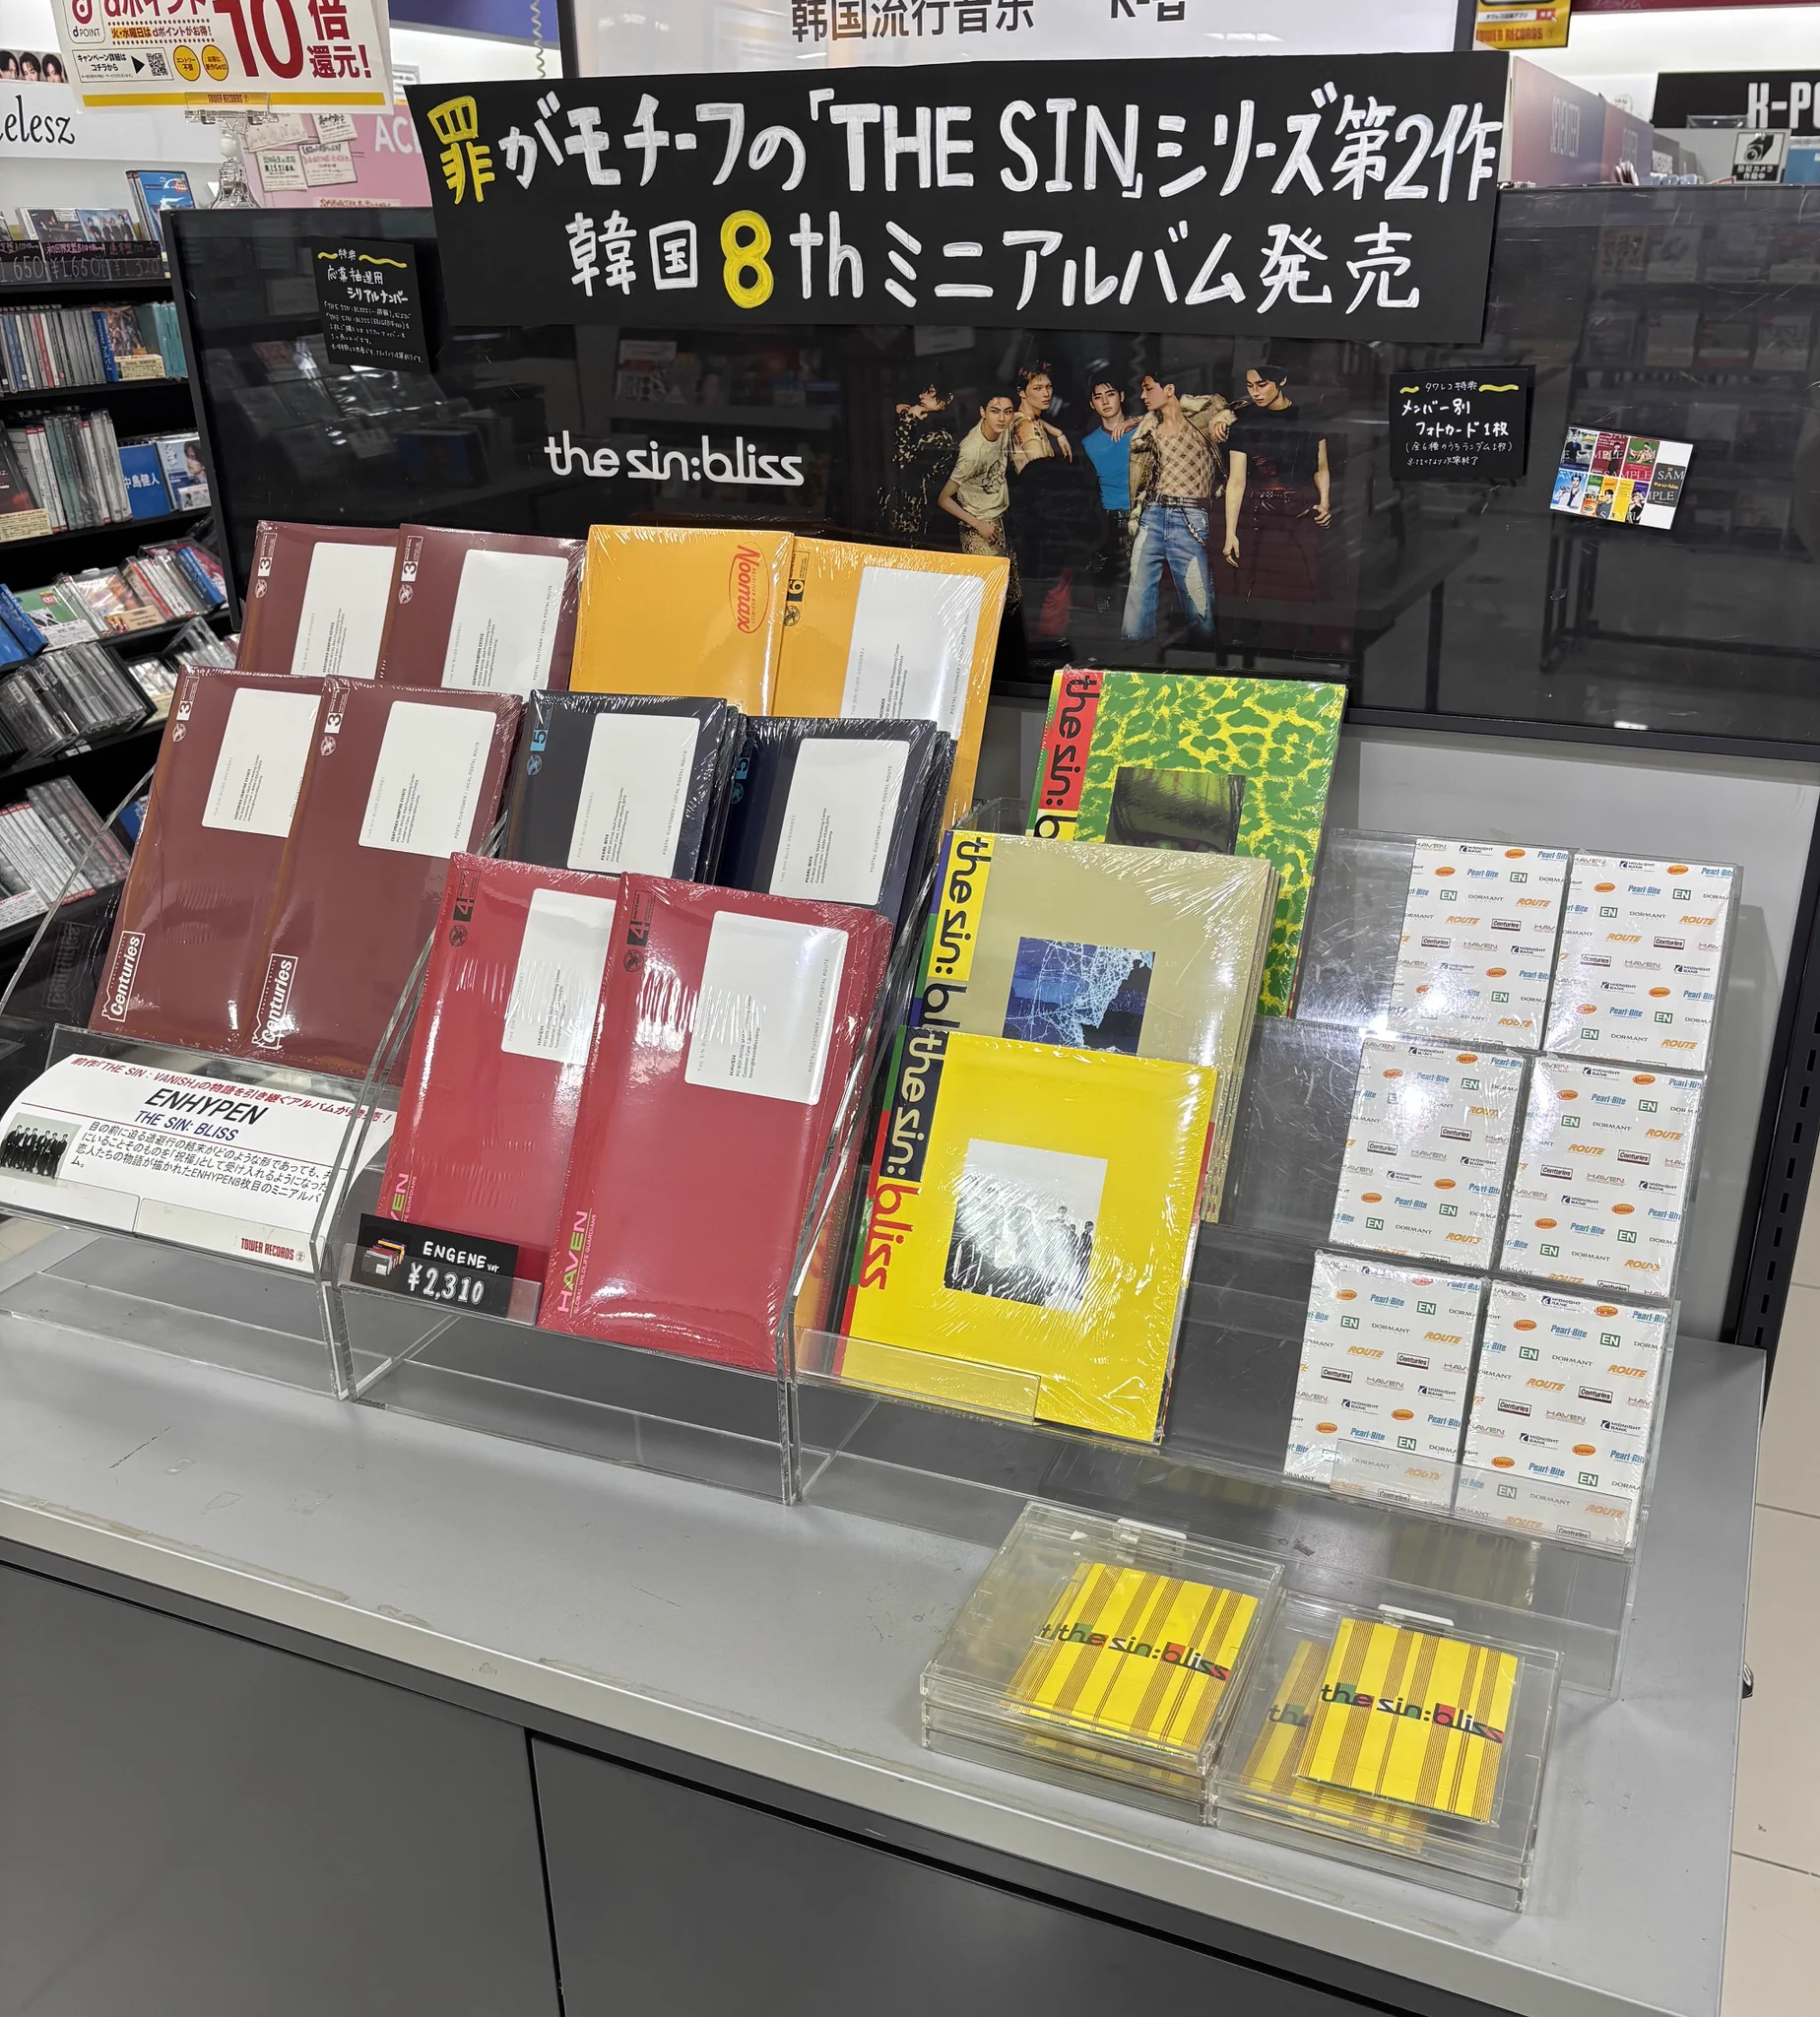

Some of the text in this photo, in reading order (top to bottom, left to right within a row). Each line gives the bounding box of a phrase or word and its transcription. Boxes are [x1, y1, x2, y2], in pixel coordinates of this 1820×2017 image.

[80, 29, 100, 37] POINT
[214, 0, 305, 80] 10
[0, 95, 76, 145] elesz
[544, 429, 806, 488] the sin:bliss
[124, 472, 161, 488] 中島健人
[737, 544, 761, 630] Noomax
[943, 836, 993, 903] the
[1441, 891, 1457, 900] EN
[1673, 890, 1690, 899] EN
[1517, 898, 1550, 907] ROUTE
[1447, 916, 1479, 925] ROUTE
[1680, 916, 1716, 925] ROUTE
[110, 935, 142, 1017] Centuries
[260, 958, 293, 1044] Centuries
[1582, 1029, 1598, 1039] EN
[1661, 1040, 1697, 1049] ROUTE
[897, 1034, 946, 1103] the
[144, 1087, 269, 1126] ENHYPEN
[1640, 1102, 1657, 1112] EN
[134, 1110, 239, 1141] THE SIN: BLISS
[1646, 1129, 1683, 1139] ROUTE
[1367, 1219, 1383, 1229] EN
[240, 1237, 295, 1262] TOWER RECORDS
[422, 1240, 488, 1269] ENGENE
[557, 1209, 588, 1313] HAVEN
[407, 1261, 486, 1306] ¥2,310
[1341, 1318, 1358, 1328] EN
[1425, 1333, 1462, 1344] ROUTE
[1601, 1334, 1619, 1346] EN
[1398, 1355, 1427, 1366] Centuries
[1552, 1355, 1593, 1366] DORMANT
[1607, 1365, 1648, 1378] ROUTE
[1527, 1379, 1565, 1391] ROUTE
[1581, 1389, 1610, 1399] Centuries
[1546, 1410, 1586, 1422] HAVEN
[1398, 1438, 1415, 1449] EN
[1586, 1505, 1624, 1519] ROUTE
[1058, 1622, 1109, 1648] the
[1320, 1682, 1373, 1709] the
